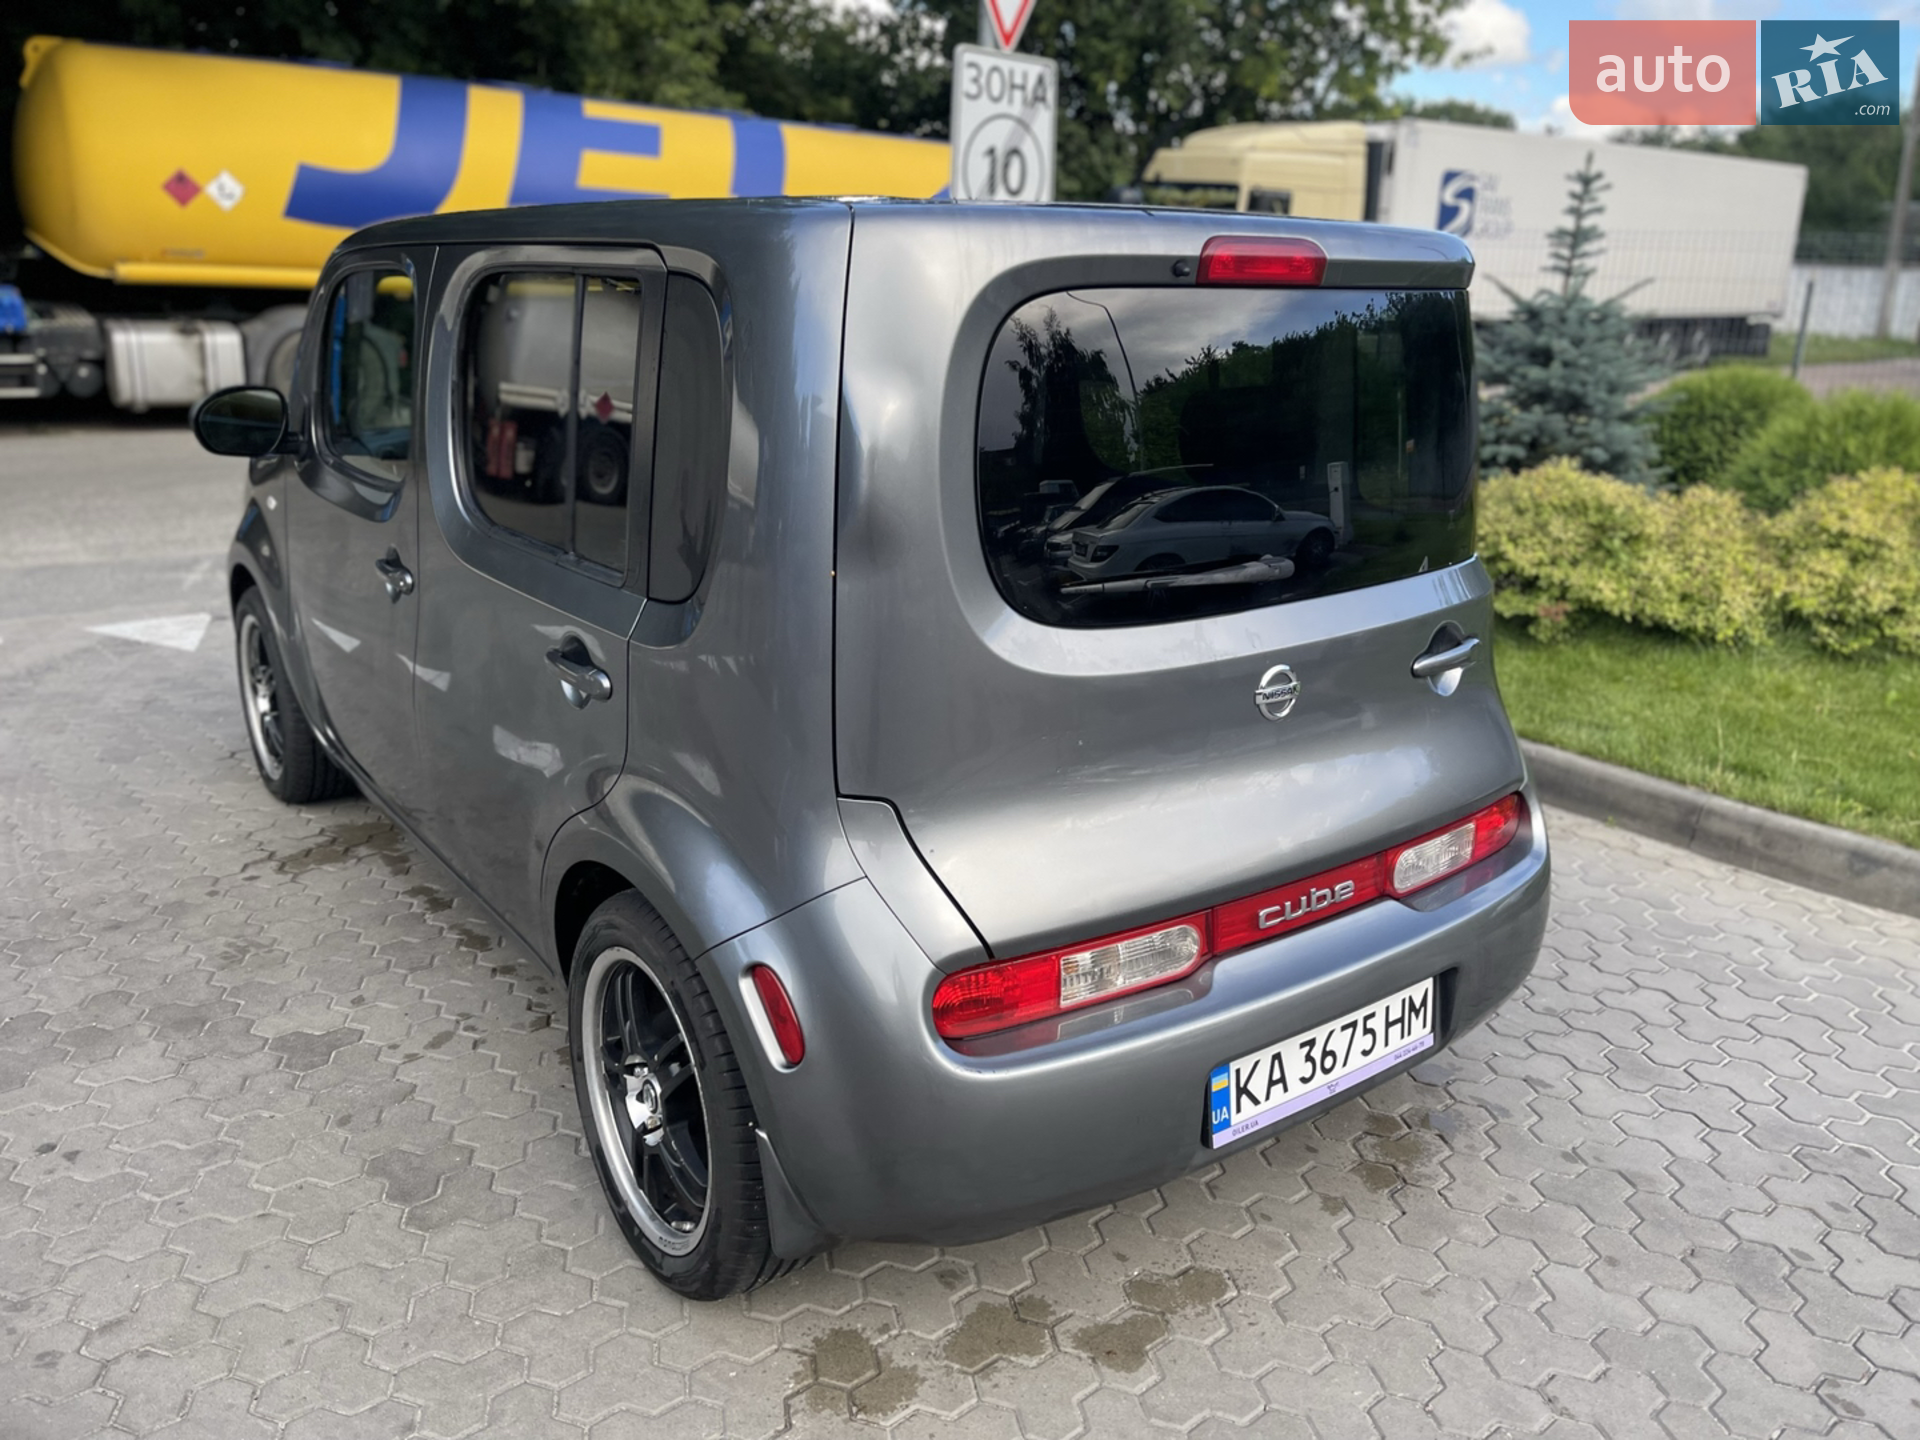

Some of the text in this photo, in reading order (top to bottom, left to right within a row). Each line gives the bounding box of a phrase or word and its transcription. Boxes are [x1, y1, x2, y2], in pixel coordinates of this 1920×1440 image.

[964, 62, 1051, 111] ЗОНА
[983, 146, 1027, 197] 10
[1298, 1011, 1377, 1085] 3675
[1212, 1106, 1230, 1125] UA
